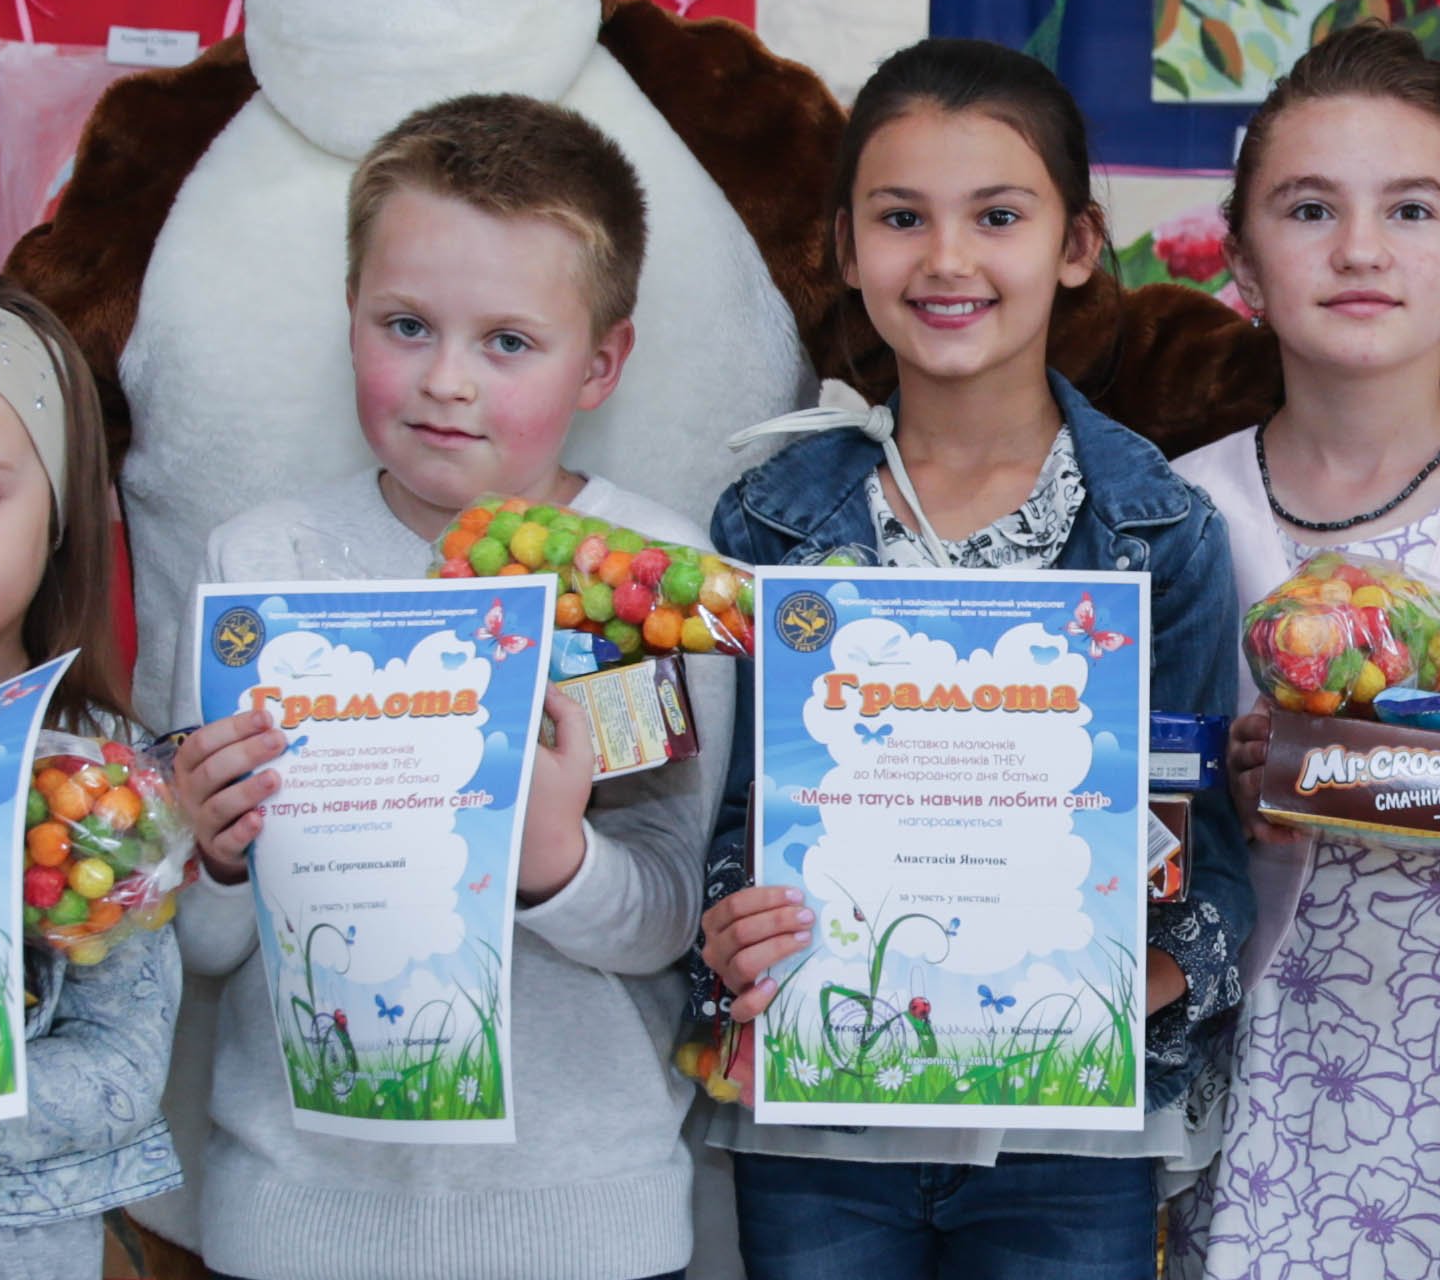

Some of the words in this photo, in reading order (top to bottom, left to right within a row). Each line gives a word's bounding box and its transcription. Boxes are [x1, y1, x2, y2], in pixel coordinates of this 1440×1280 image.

[823, 672, 1080, 717] Грамота
[250, 686, 481, 730] Грамота
[887, 737, 949, 750] Виставка
[952, 737, 1016, 751] малюнків
[876, 754, 908, 766] дітей
[912, 754, 990, 768] працівників
[853, 770, 869, 781] до
[873, 769, 972, 784] Міжнародного
[976, 772, 998, 783] дня
[1002, 769, 1049, 783] батька
[271, 802, 317, 818] татусь
[323, 798, 378, 813] навчив
[382, 793, 444, 811] любити
[449, 791, 494, 808] світ!»
[792, 789, 853, 807] «Мене
[858, 792, 914, 811] татусь
[920, 792, 983, 807] навчив
[988, 791, 1058, 809] любити
[1062, 792, 1111, 810] світ!»
[898, 816, 1003, 830] нагороджується
[893, 853, 956, 866] Анастасія
[960, 853, 1008, 867] Яночок
